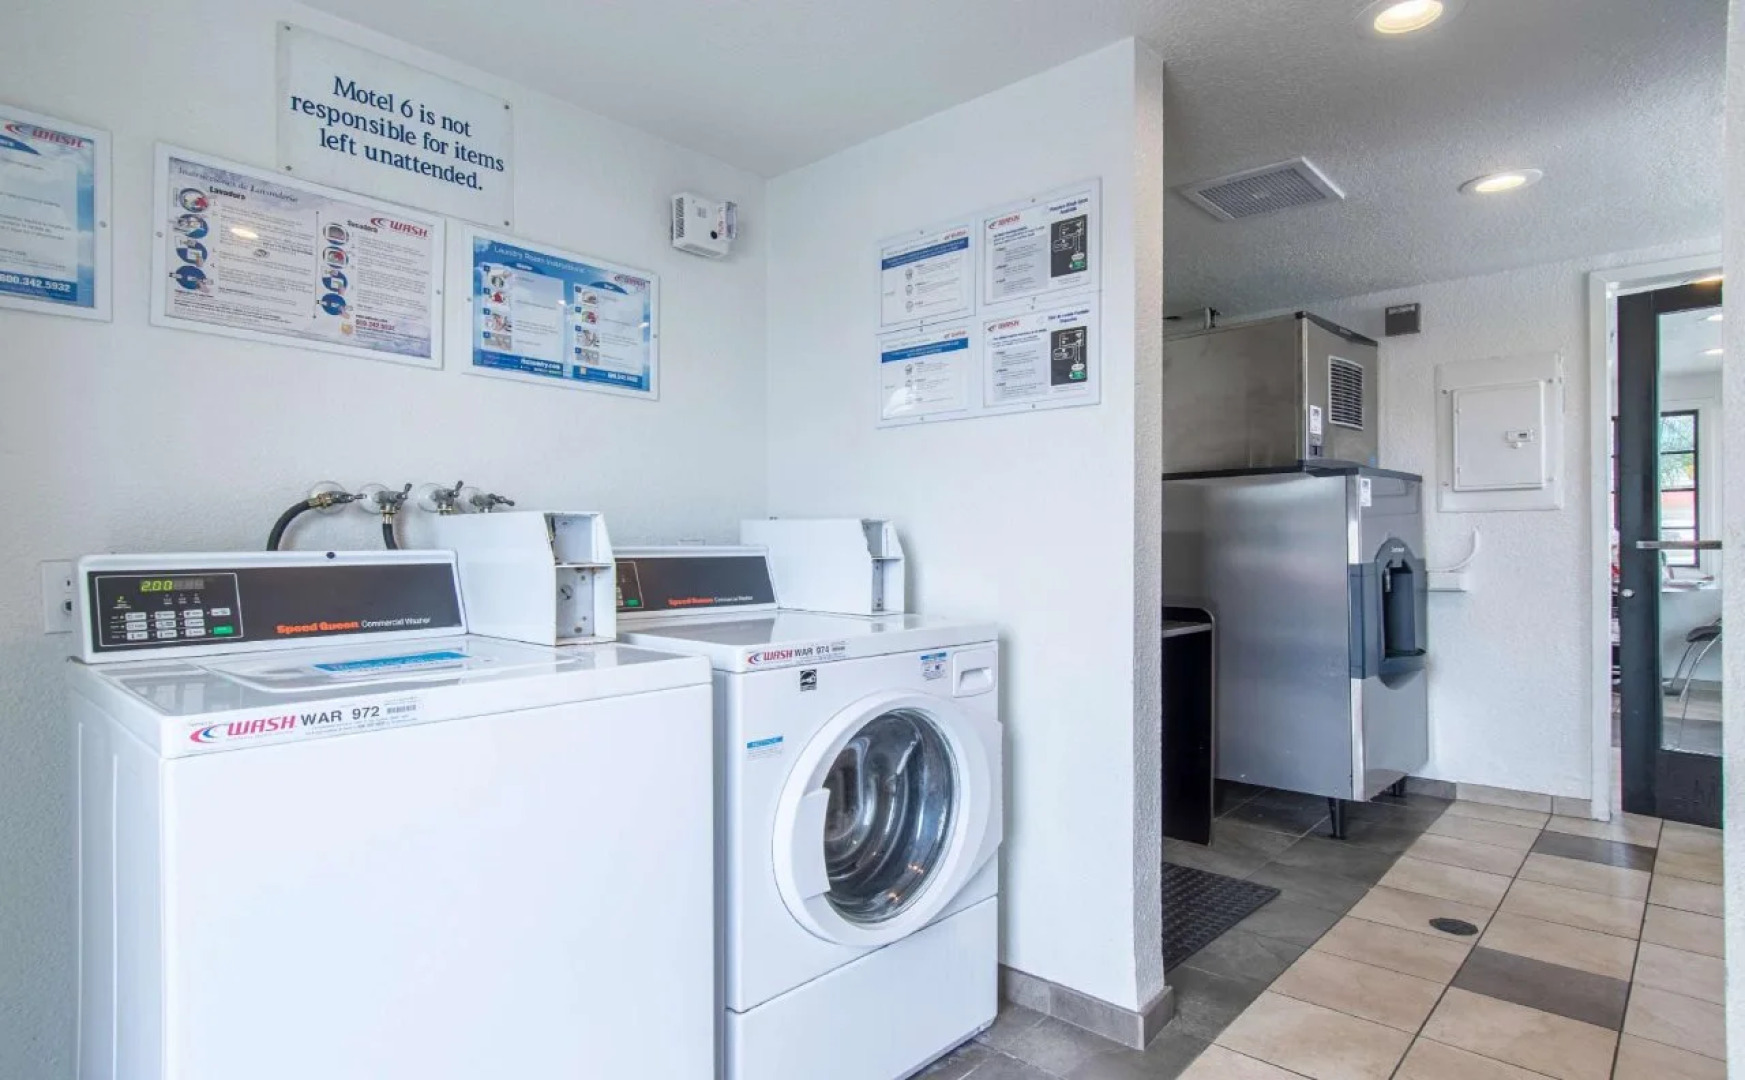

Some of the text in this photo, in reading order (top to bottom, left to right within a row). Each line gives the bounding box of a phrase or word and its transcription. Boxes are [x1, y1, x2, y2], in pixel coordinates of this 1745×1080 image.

[333, 76, 472, 137] Motel 6 is not
[32, 129, 84, 149] WASH
[291, 95, 504, 172] responsible for items
[319, 127, 483, 191] left unattended.
[209, 185, 246, 201] Lavadora
[389, 219, 428, 238] WASH
[140, 580, 174, 592] 2.00
[276, 615, 432, 636] Speed Queen Commercial Washer
[762, 648, 794, 662] WASH
[794, 647, 814, 658] WAR
[226, 714, 297, 736] WASH
[300, 709, 343, 727] WAR
[352, 705, 381, 721] 972
